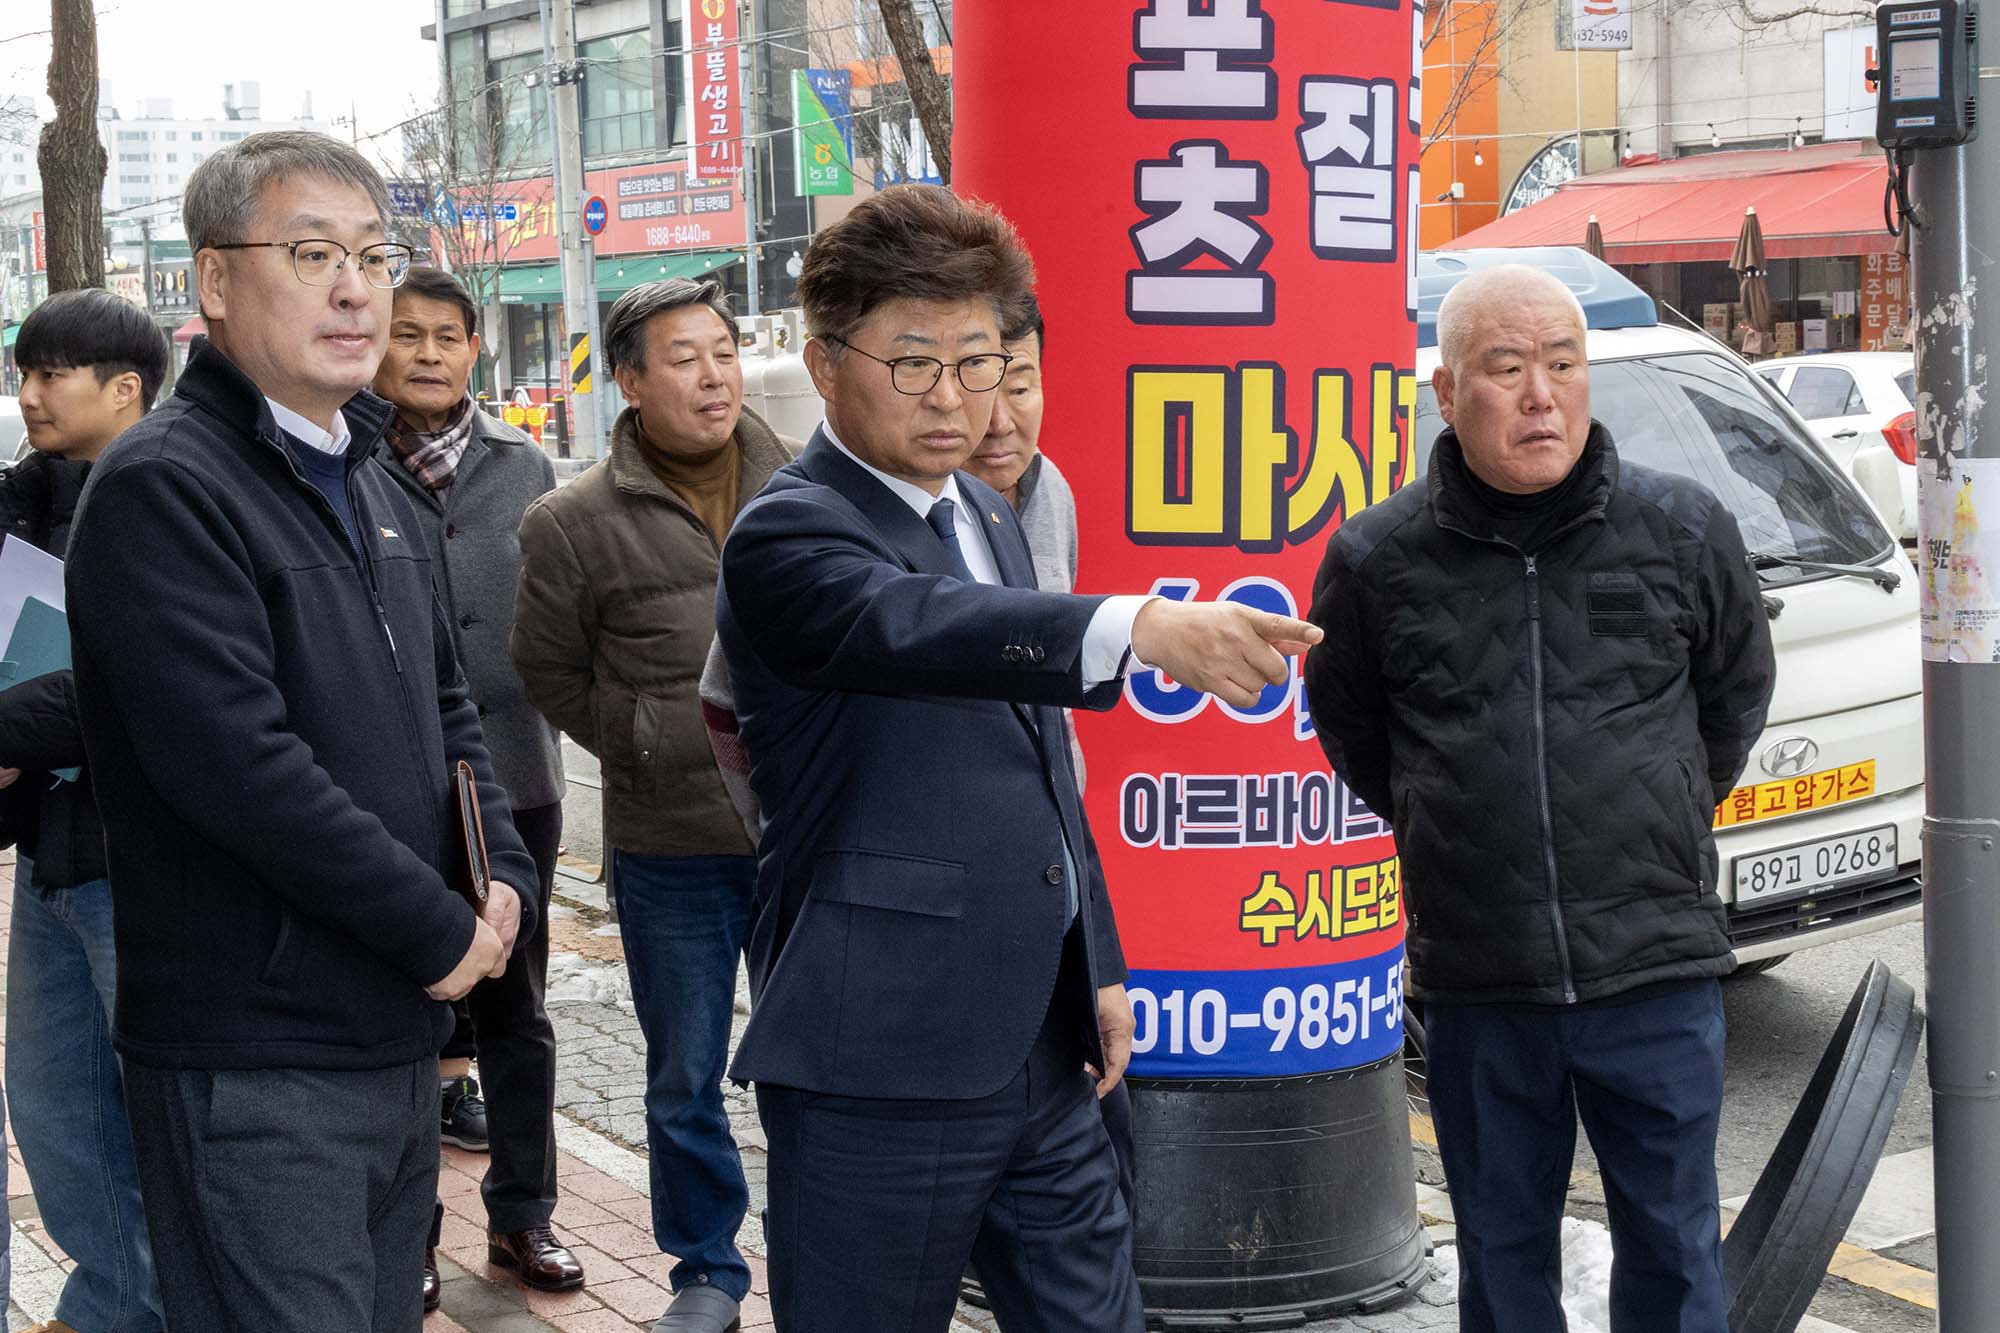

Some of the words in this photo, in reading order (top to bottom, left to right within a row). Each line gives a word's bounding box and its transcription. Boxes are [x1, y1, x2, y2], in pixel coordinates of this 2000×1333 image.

[646, 223, 702, 246] 1688-6440
[1751, 854, 1802, 893] 89고
[1816, 836, 1882, 878] 0268
[1240, 856, 1401, 946] 수시모집
